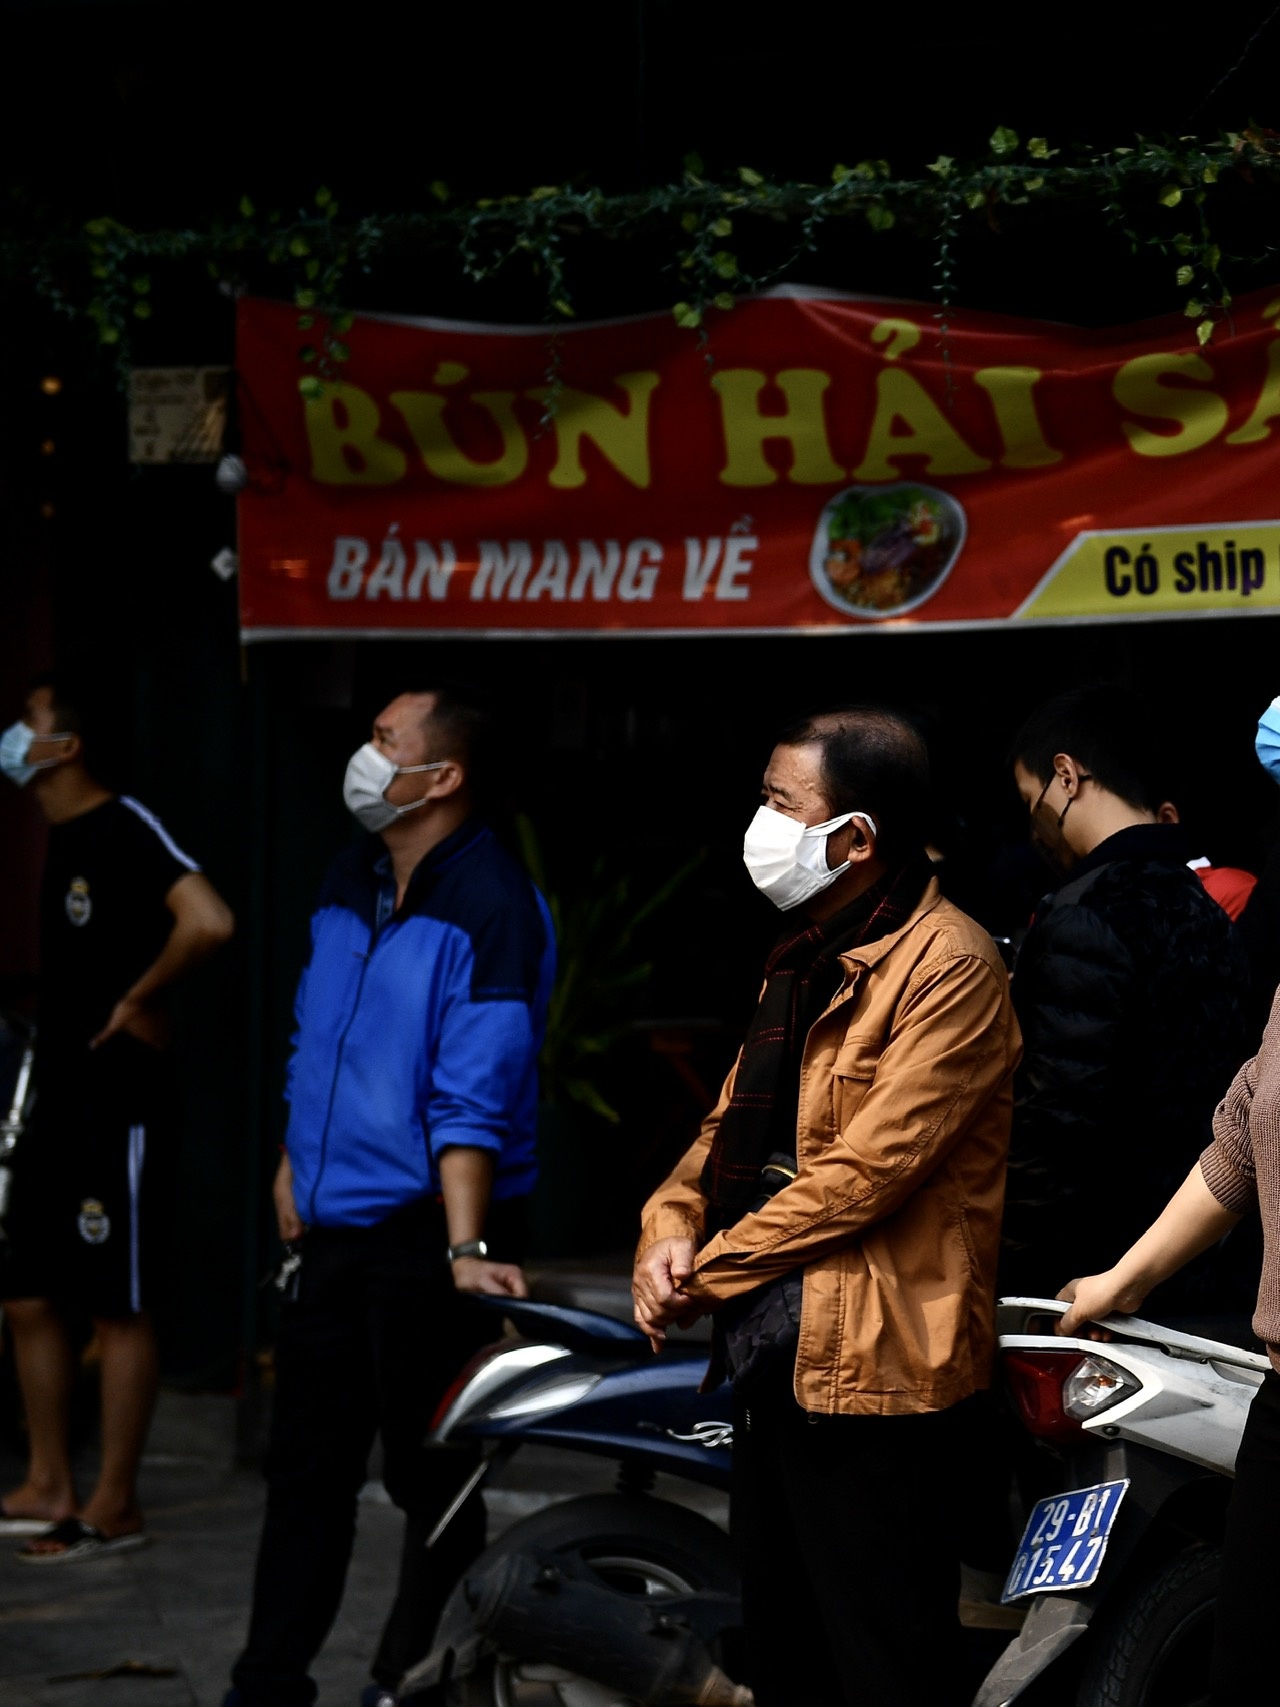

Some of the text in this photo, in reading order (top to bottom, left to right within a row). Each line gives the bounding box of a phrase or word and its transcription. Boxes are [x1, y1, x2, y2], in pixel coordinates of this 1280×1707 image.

[299, 361, 662, 491] BÚN
[711, 317, 1063, 486] HẢI
[325, 511, 761, 603] BÁN MANG VỀ
[1105, 542, 1159, 596] Có
[1175, 541, 1265, 596] ship
[1030, 1489, 1111, 1546] 29-B1
[1007, 1536, 1103, 1595] 015.47
